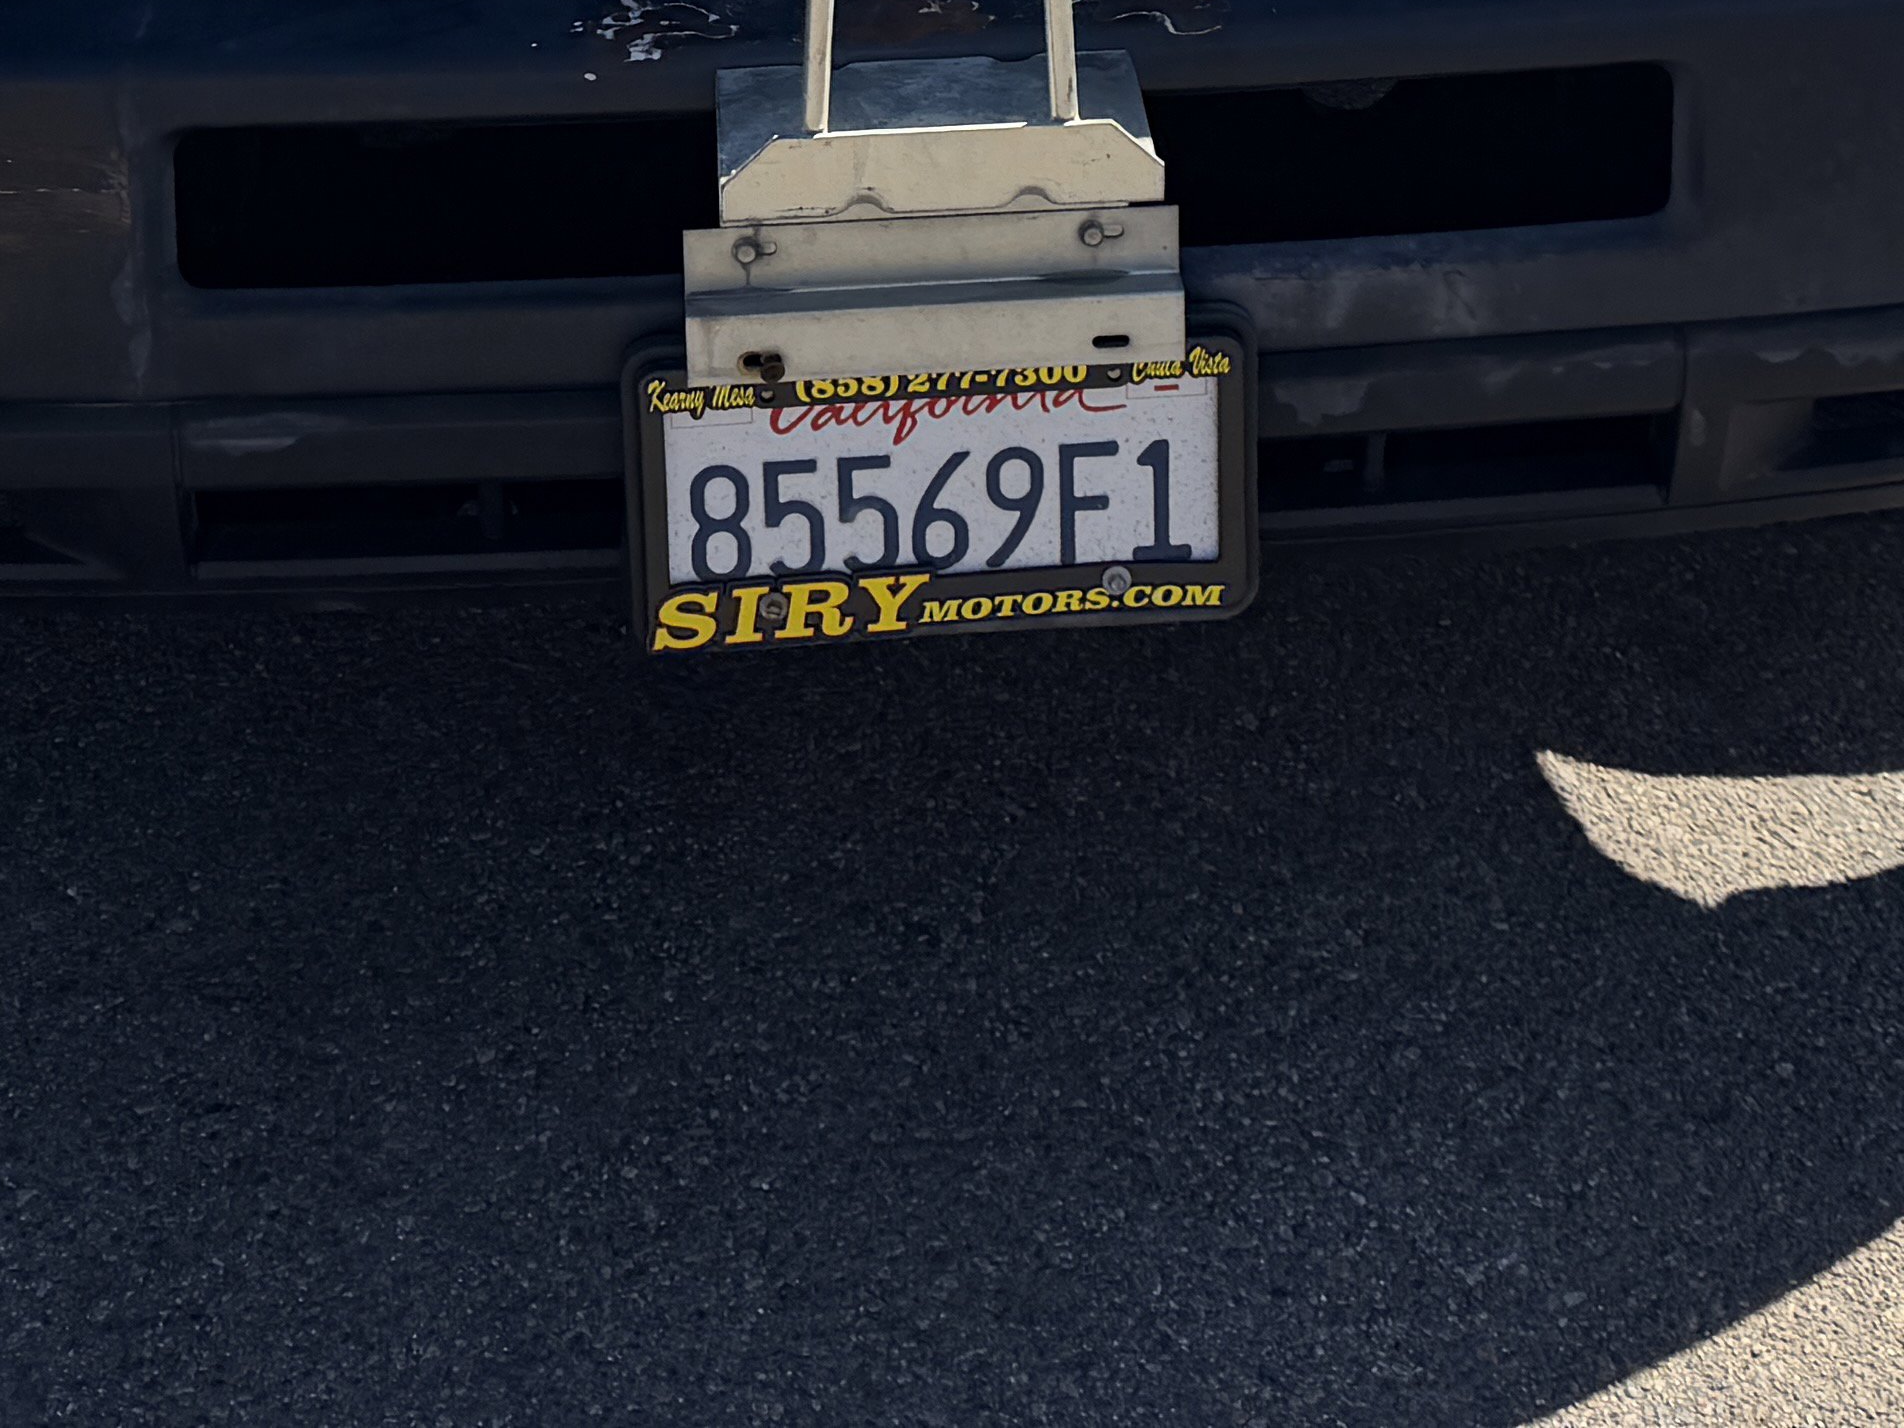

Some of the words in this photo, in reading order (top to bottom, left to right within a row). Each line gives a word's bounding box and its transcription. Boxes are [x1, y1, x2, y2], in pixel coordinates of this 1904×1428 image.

[647, 380, 705, 416] Kearny
[1189, 347, 1232, 375] Vista
[689, 439, 1192, 582] 85569F1
[652, 572, 932, 651] SIRY
[918, 584, 1225, 625] MOTORS.COM
